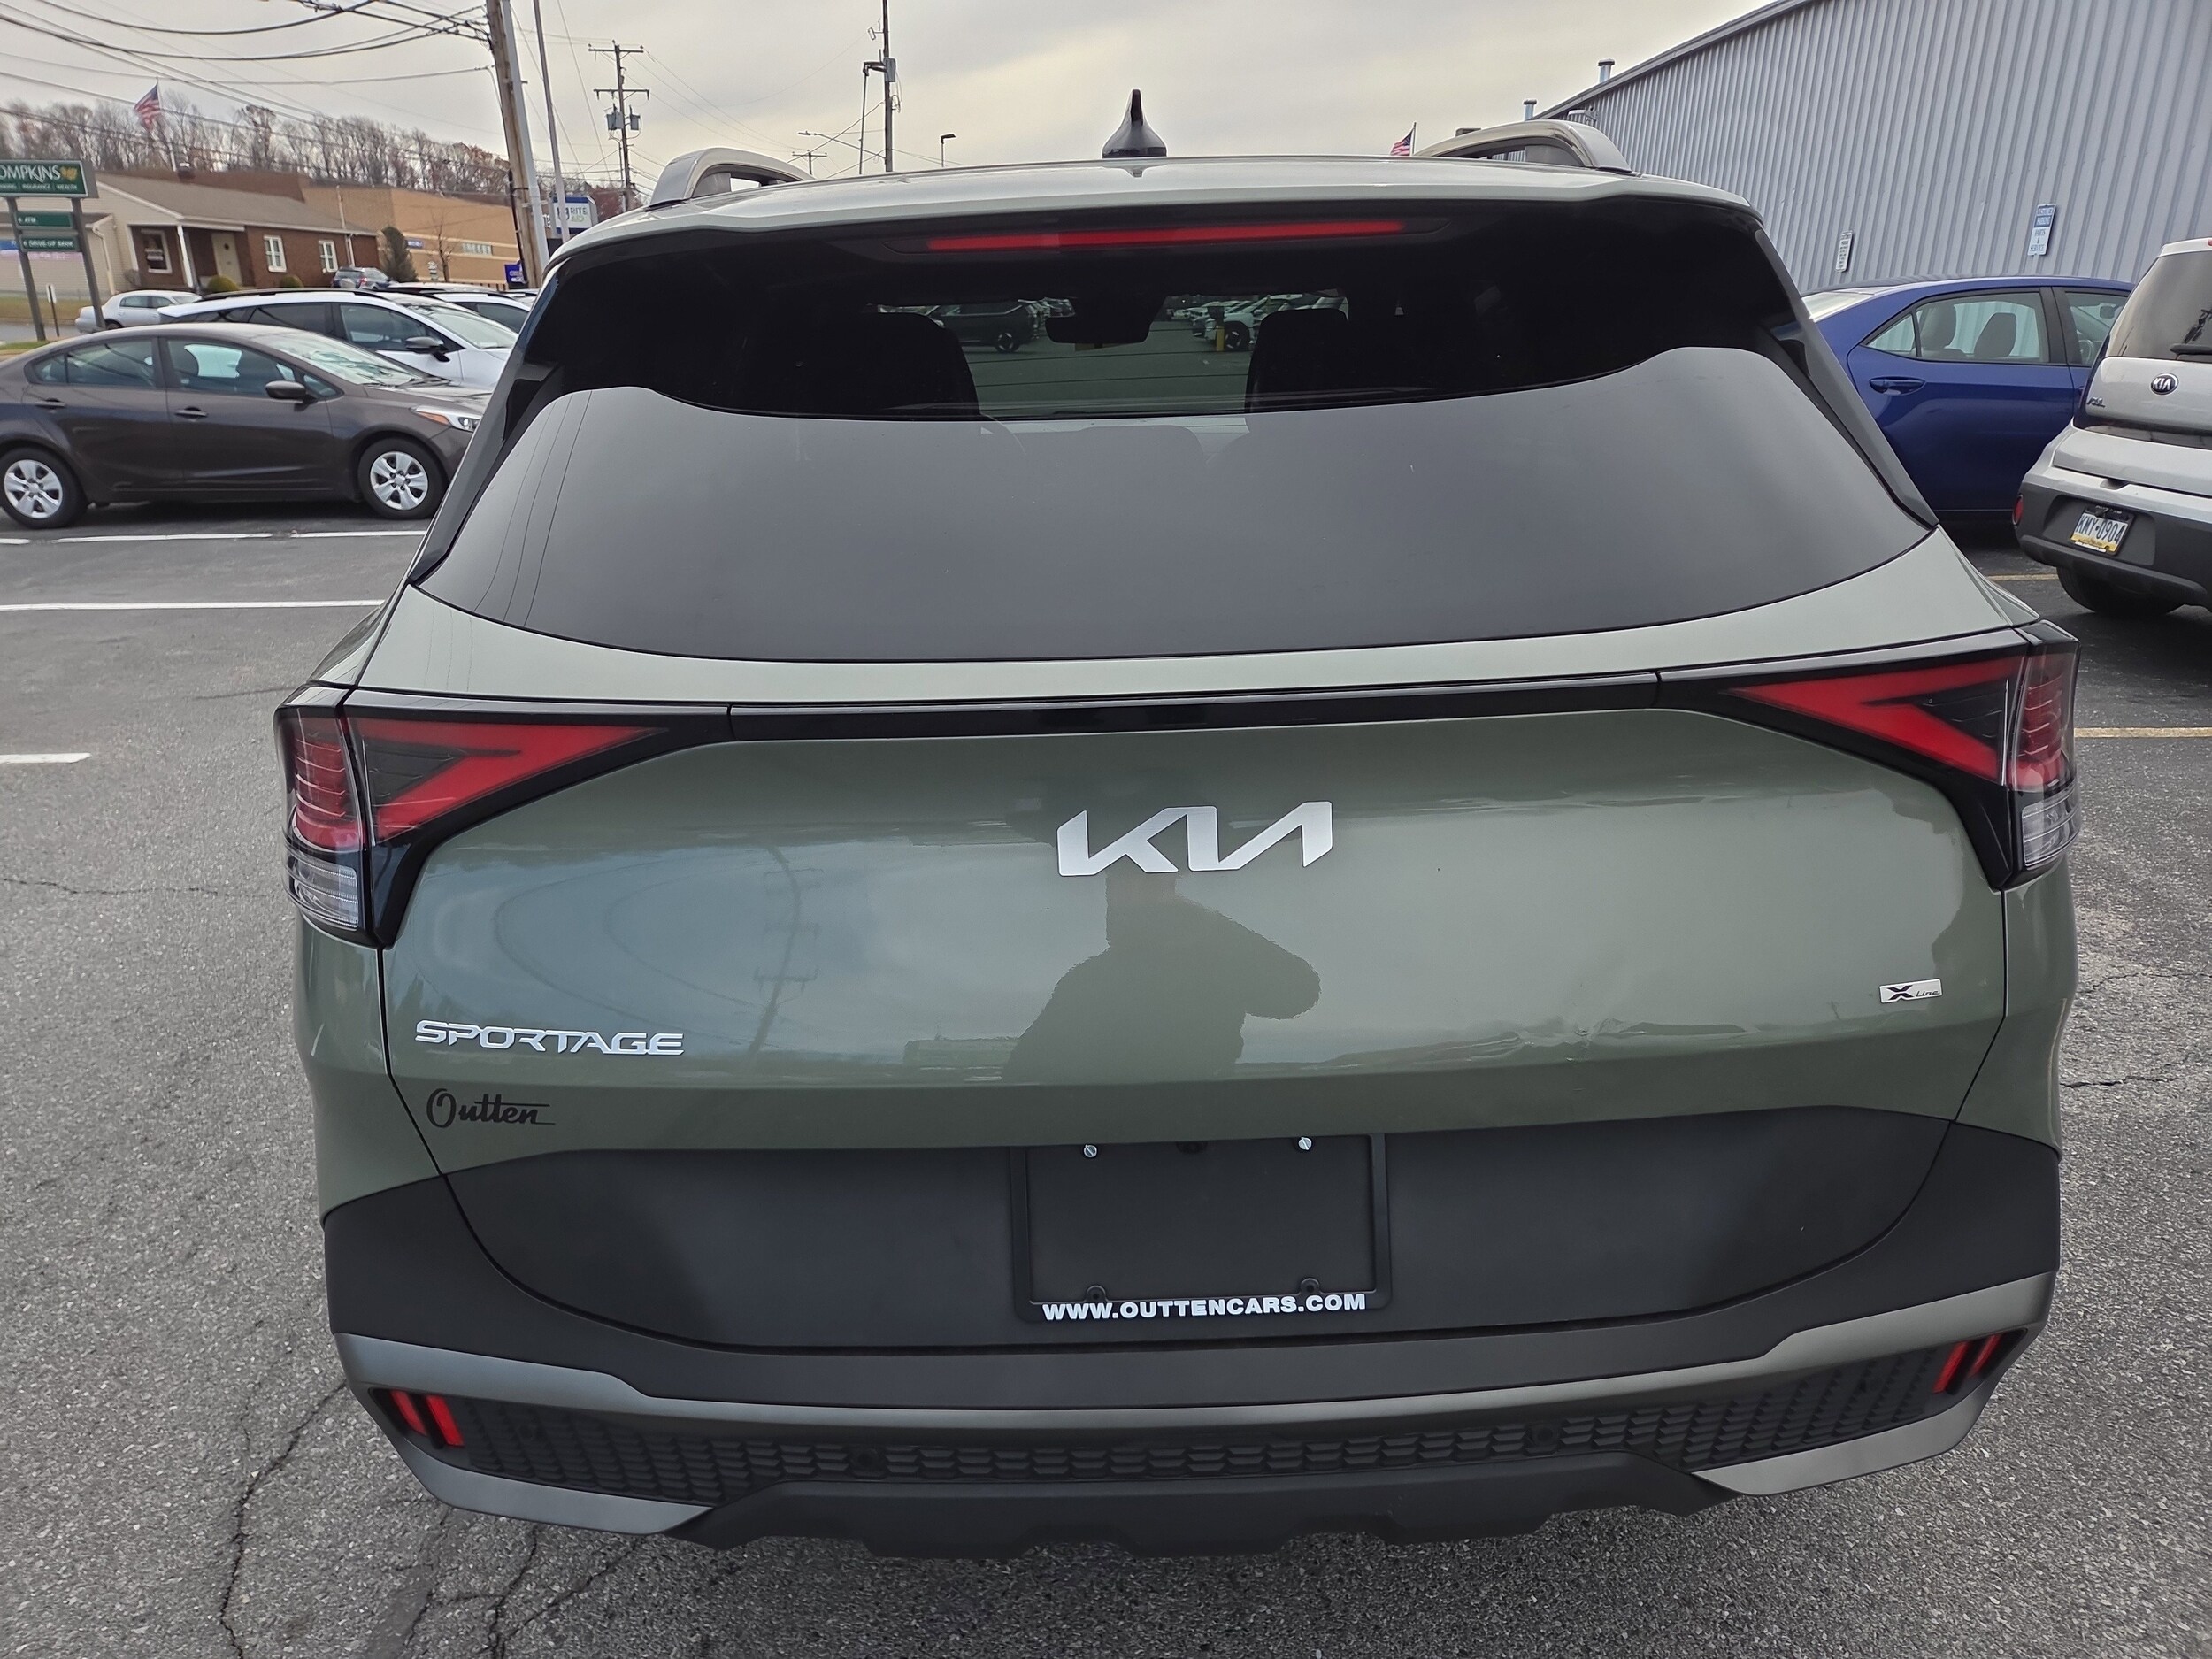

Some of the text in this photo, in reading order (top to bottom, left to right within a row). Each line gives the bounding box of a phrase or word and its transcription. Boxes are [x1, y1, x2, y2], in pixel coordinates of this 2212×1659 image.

[0, 165, 60, 183] OMPKINS
[2153, 377, 2173, 390] KIA
[1057, 801, 1333, 876] KIA
[415, 1019, 685, 1056] SPORTAGE
[426, 1087, 556, 1128] Outten
[1042, 1294, 1366, 1321] WWW.OUTTENCARS.COM
